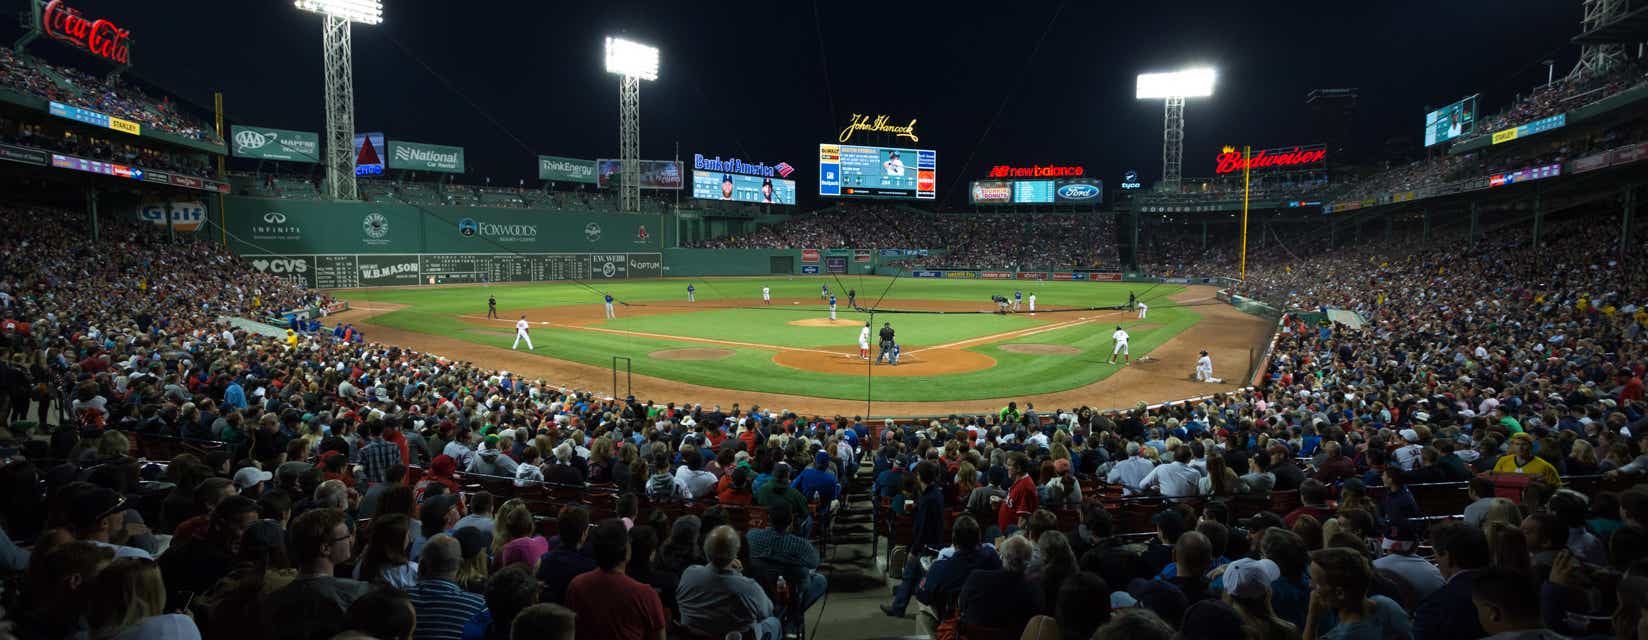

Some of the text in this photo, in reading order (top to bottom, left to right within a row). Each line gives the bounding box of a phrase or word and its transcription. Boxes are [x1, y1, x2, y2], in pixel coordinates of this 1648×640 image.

[840, 113, 918, 142] John Hancock
[238, 131, 264, 148] AAA
[410, 148, 457, 164] National
[1216, 146, 1327, 174] Budweiser
[695, 153, 775, 177] Bank of America
[1010, 167, 1033, 177] new
[1034, 164, 1083, 177] balance
[1066, 187, 1090, 198] Ford
[1121, 182, 1141, 190] tyco
[270, 259, 307, 273] CVS
[637, 262, 660, 270] OPTUM
